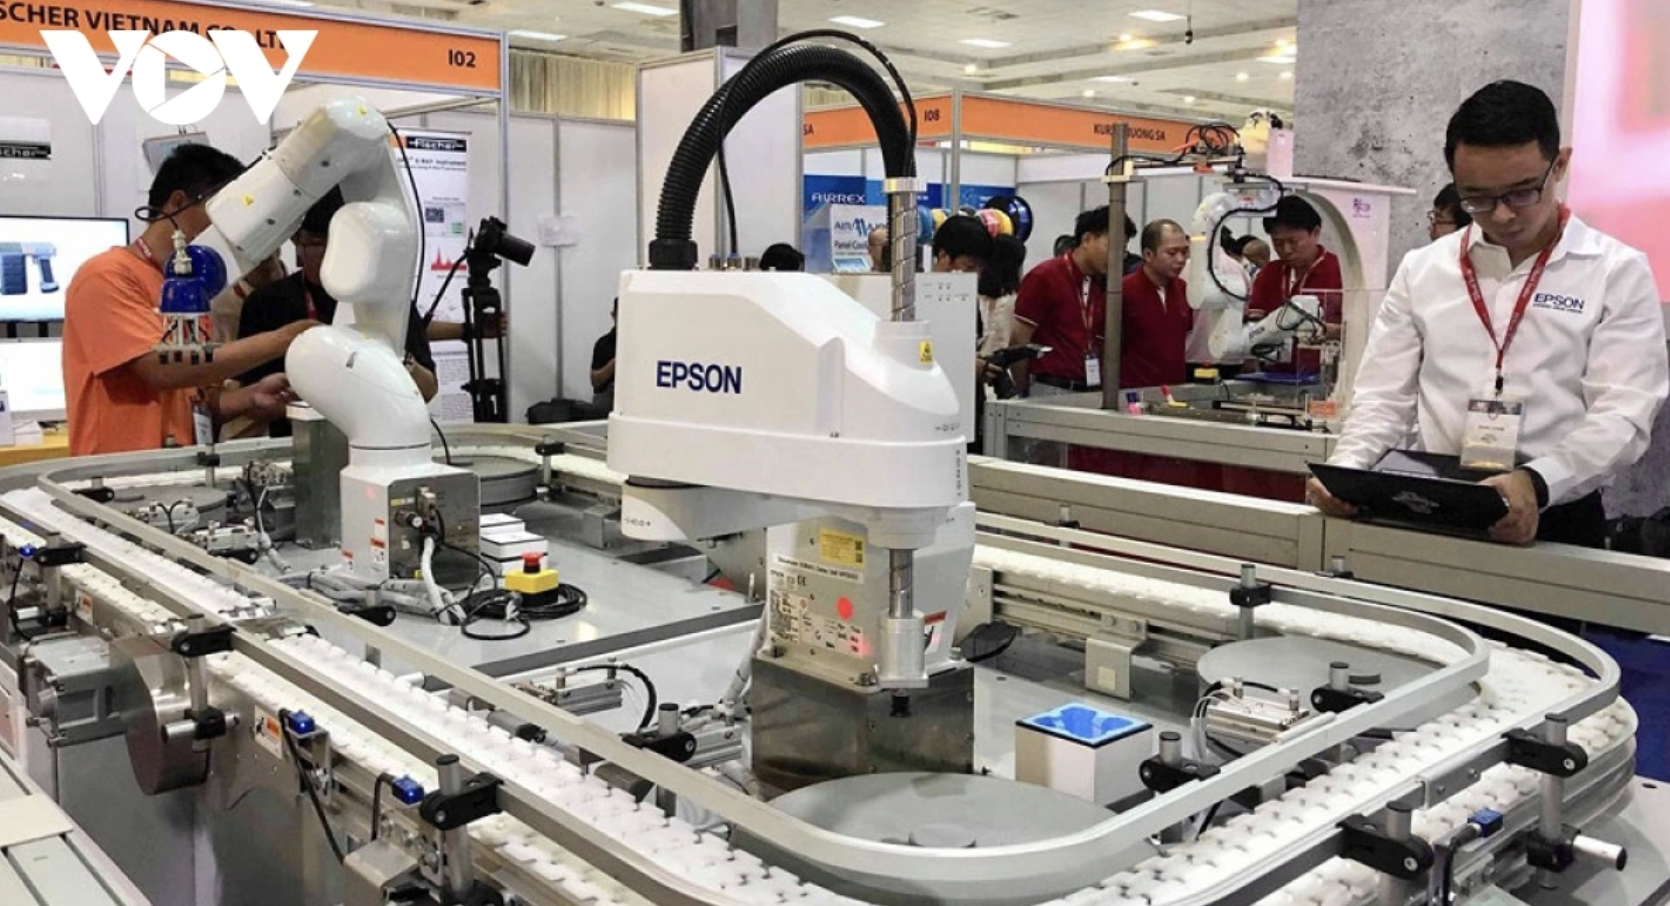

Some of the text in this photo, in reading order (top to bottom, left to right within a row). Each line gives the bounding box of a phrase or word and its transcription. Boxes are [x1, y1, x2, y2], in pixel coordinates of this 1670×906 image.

[255, 28, 285, 49] LT
[811, 192, 867, 204] AIRREX
[1534, 292, 1585, 310] EPSON
[656, 359, 742, 395] EPSON
